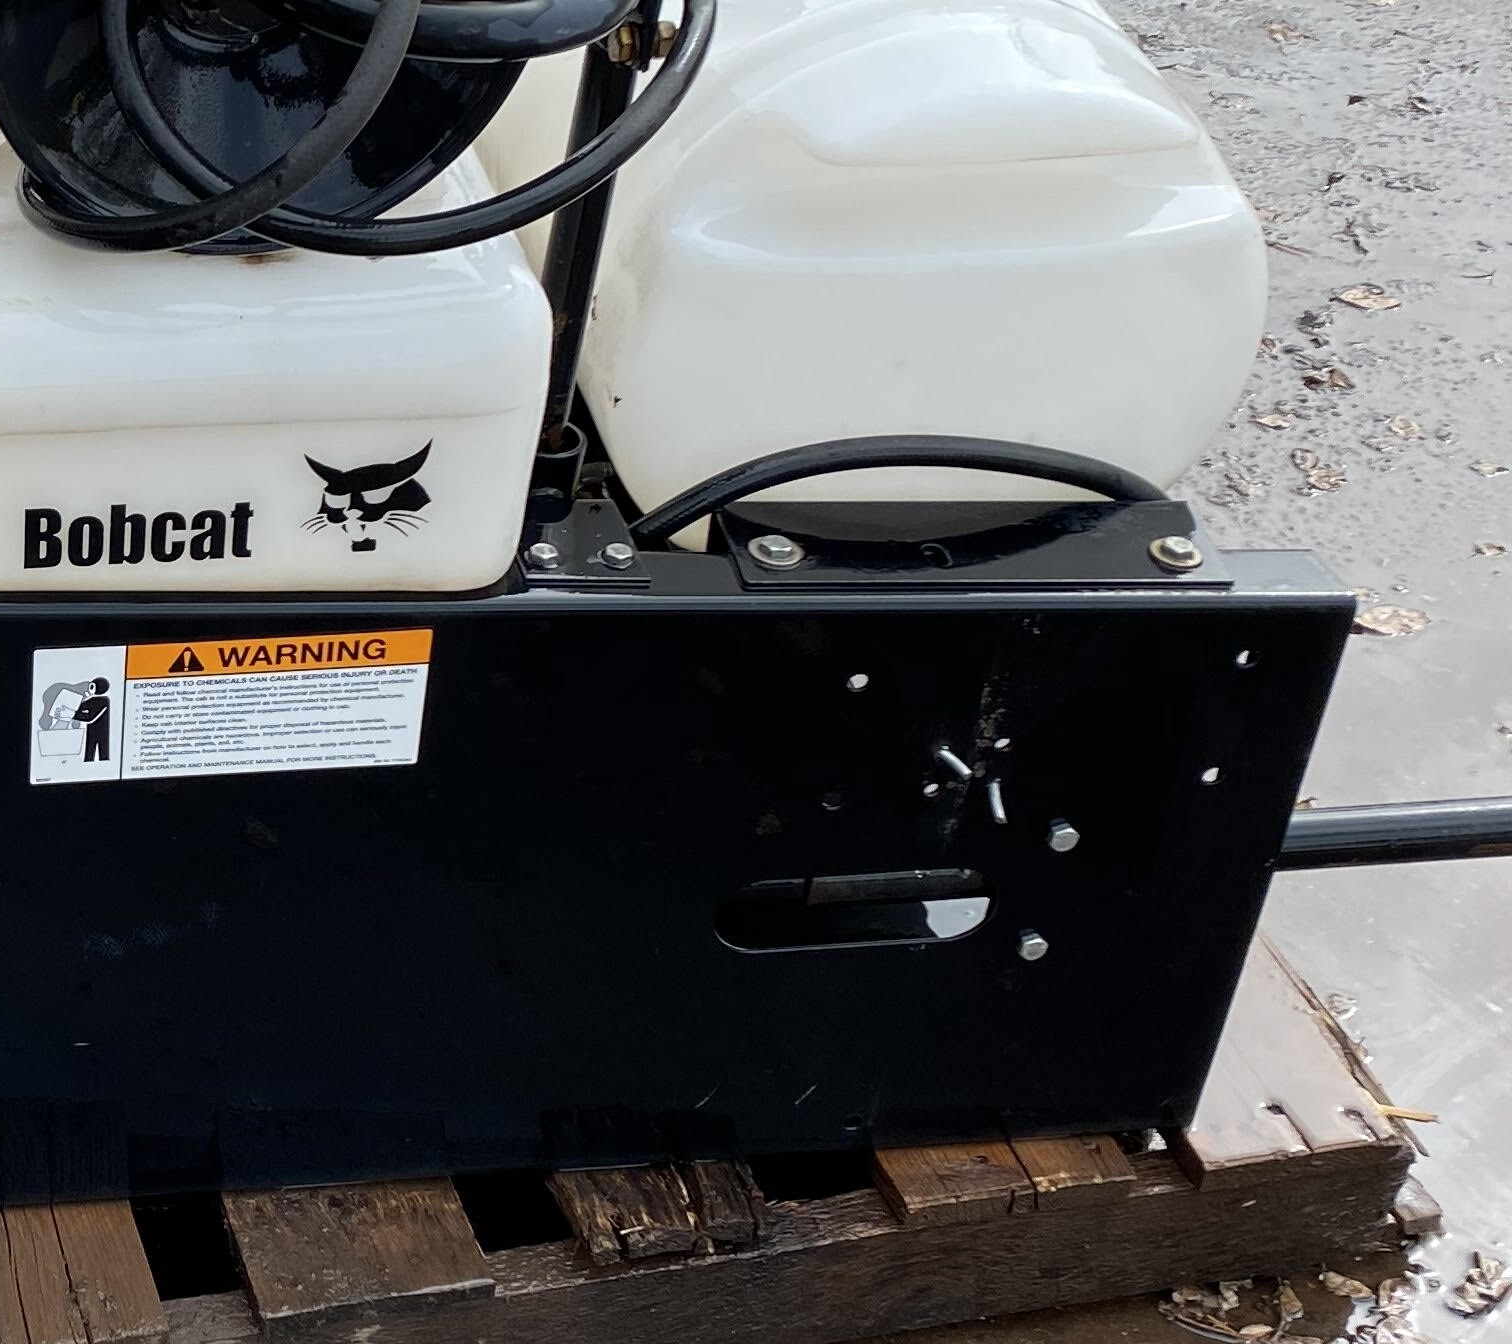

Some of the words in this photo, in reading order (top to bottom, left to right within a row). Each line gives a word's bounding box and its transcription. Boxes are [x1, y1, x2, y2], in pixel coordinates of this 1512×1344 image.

[24, 502, 254, 569] Bobcat
[218, 639, 386, 668] WARNING
[133, 680, 180, 689] EXPOSURE
[195, 677, 246, 685] CHEMICALS
[300, 672, 339, 680] SERIOUS
[340, 670, 372, 678] INJURY
